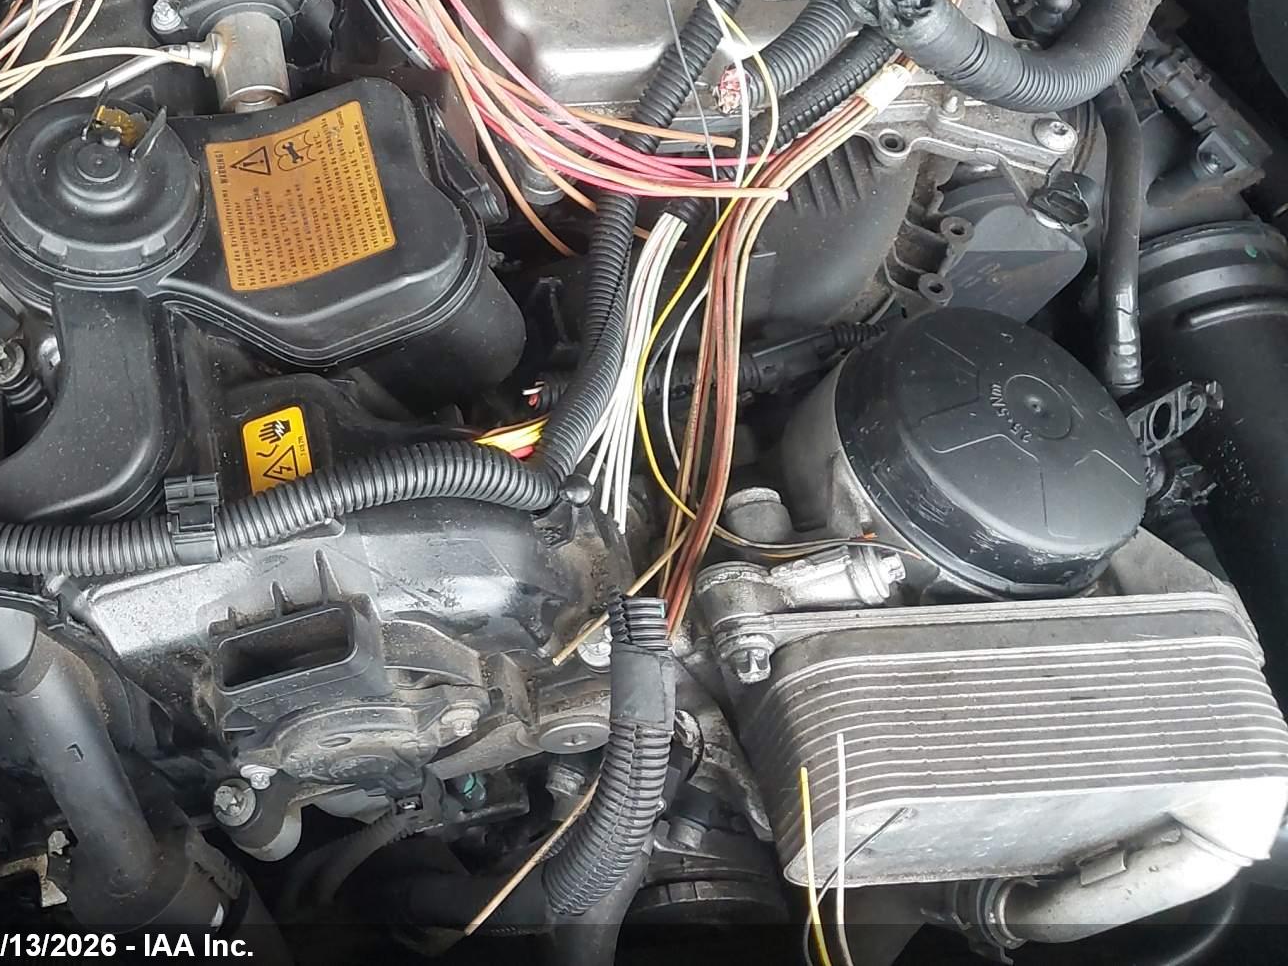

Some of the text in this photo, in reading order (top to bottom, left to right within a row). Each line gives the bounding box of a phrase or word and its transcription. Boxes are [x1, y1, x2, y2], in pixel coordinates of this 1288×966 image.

[213, 148, 228, 185] WARNING!
[333, 166, 343, 192] sistema
[345, 175, 360, 216] temperatura
[256, 212, 265, 226] fuel
[264, 190, 276, 231] temperature
[341, 204, 350, 220] abrir
[249, 227, 258, 245] nicht
[331, 206, 348, 259] refroidissement
[346, 223, 358, 255] Prohibido
[358, 227, 369, 251] cuando
[364, 206, 378, 247] refrigerante
[264, 241, 272, 257] open
[273, 233, 283, 258] coolant
[287, 248, 296, 267] above
[316, 234, 329, 266] carburant
